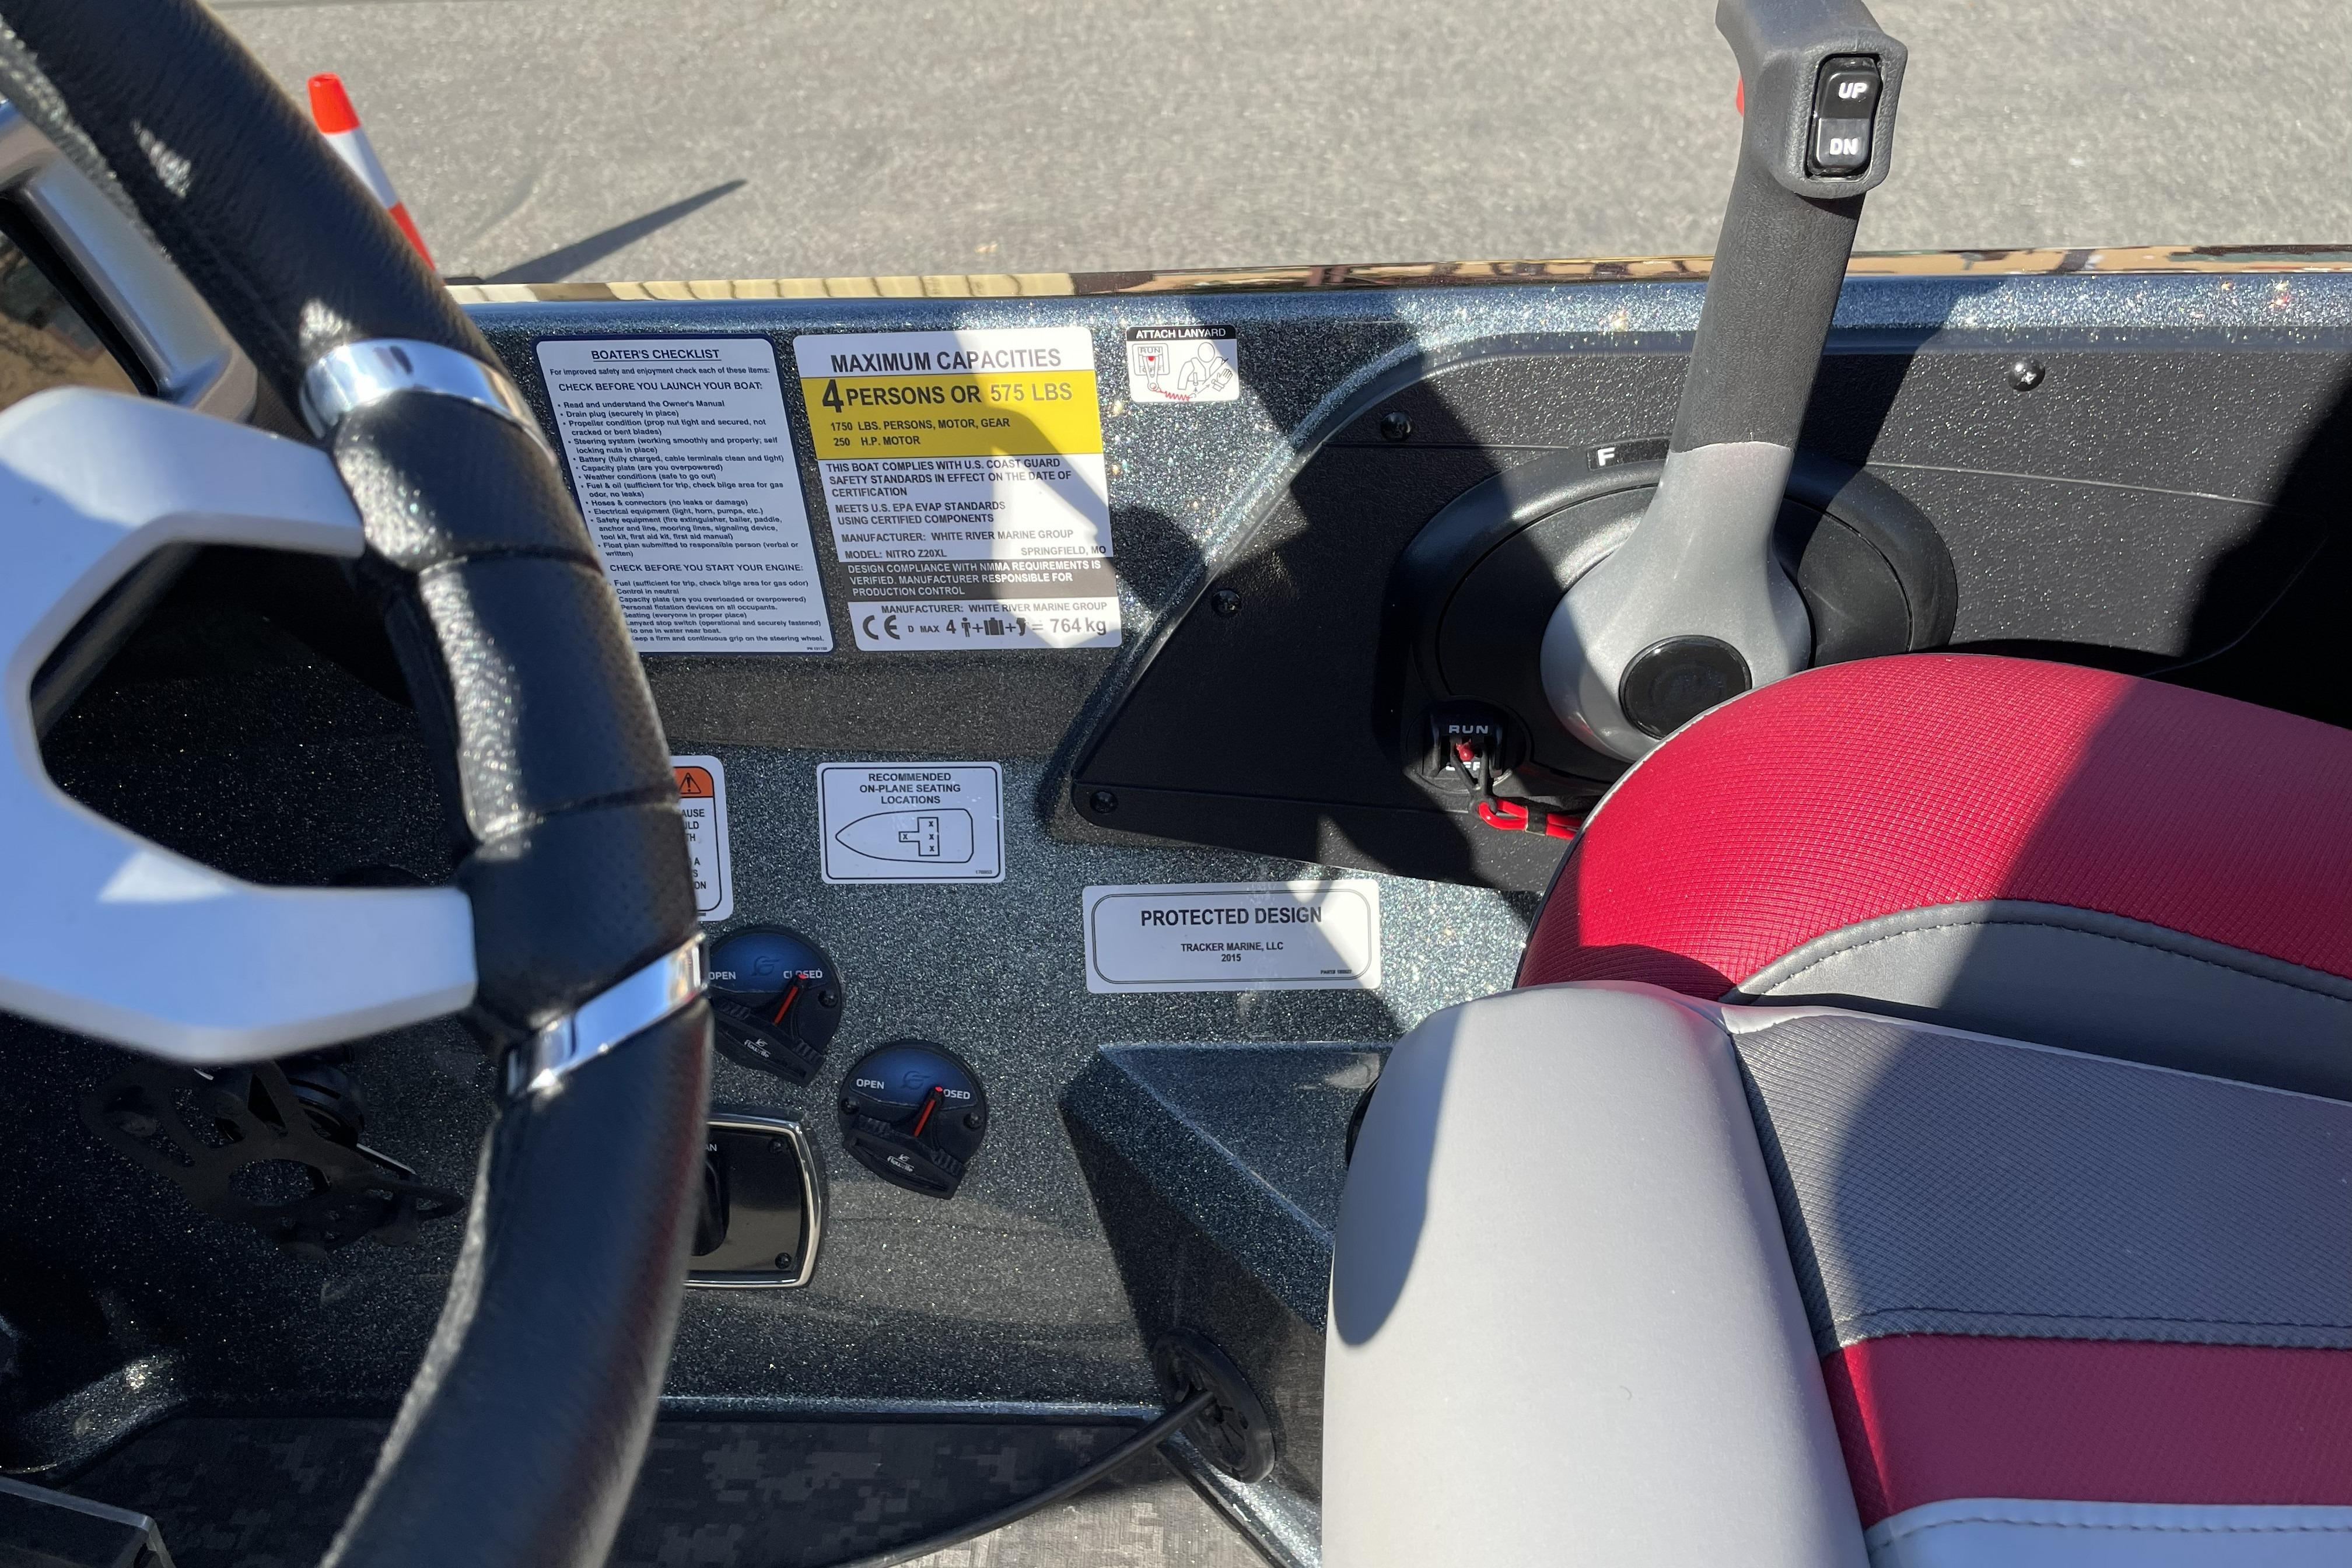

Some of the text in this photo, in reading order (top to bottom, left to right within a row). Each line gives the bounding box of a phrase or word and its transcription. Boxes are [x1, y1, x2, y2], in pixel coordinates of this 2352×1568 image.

[1838, 83, 1867, 99] UP
[1829, 138, 1859, 155] DN
[1136, 328, 1226, 338] ATTACH LANYARD
[591, 349, 719, 359] BOATER'S CHECKLIST
[831, 348, 1061, 373] MAXIMUM CAPACITIES
[636, 368, 674, 376] enjoyment
[703, 382, 732, 390] YOUR
[734, 382, 762, 390] BOAT:
[822, 379, 1072, 413] 4 PERSONS OR 575 LBS
[608, 410, 643, 418] (securely
[655, 410, 679, 418] place)
[831, 418, 1010, 431] 1750 LBS. PERSONS, MOTOR, GEAR
[833, 436, 921, 446] 250 H.P. MOTOR
[1598, 447, 1615, 466] F
[826, 458, 1060, 473] THIS BOAT COMPLIES WITH U.S. COAST GUARD
[829, 470, 1071, 485] SAFETY STANDARDS IN EFFECT ON THE DATE OF
[832, 487, 907, 497] CERTIFICATION
[835, 501, 1006, 513] MEETS U.S. EPA EVAP STANDARDS
[837, 513, 994, 525] USING CERTIFIED COMPONENTS
[841, 530, 1073, 542] MANUFACTURER: WHITE RIVER MARINE GROUP
[845, 549, 947, 559] MODEL: NITRO Z20XL
[1021, 545, 1106, 555] SPRINGFIELD, MO
[848, 560, 1101, 573] DESIGN COMPLIANCE WITH NMMA REQUIREMENTS IS
[849, 572, 1073, 584] VERIFIED. MANUFACTURER RESPONSIBLE FOR
[852, 586, 965, 596] PRODUCTION CONTROL
[881, 604, 964, 615] MANUFACTURER:
[968, 604, 999, 613] WHITE
[1033, 603, 1070, 611] MARINE
[1072, 602, 1107, 611] GROUP
[945, 620, 956, 634] 4
[1050, 618, 1082, 633] 764
[1085, 617, 1108, 635] kg
[1448, 725, 1489, 734] RUN
[869, 773, 951, 781] RECOMMENDED
[860, 784, 961, 793] ON-PLANE SEATING
[881, 796, 941, 804] LOCATIONS
[1141, 907, 1322, 926] PROTECTED DESIGN
[1181, 942, 1284, 951] TRACKER MARINE, LLC
[1222, 954, 1241, 962] 2015
[709, 971, 736, 980] OPEN
[856, 1079, 884, 1090] OPEN
